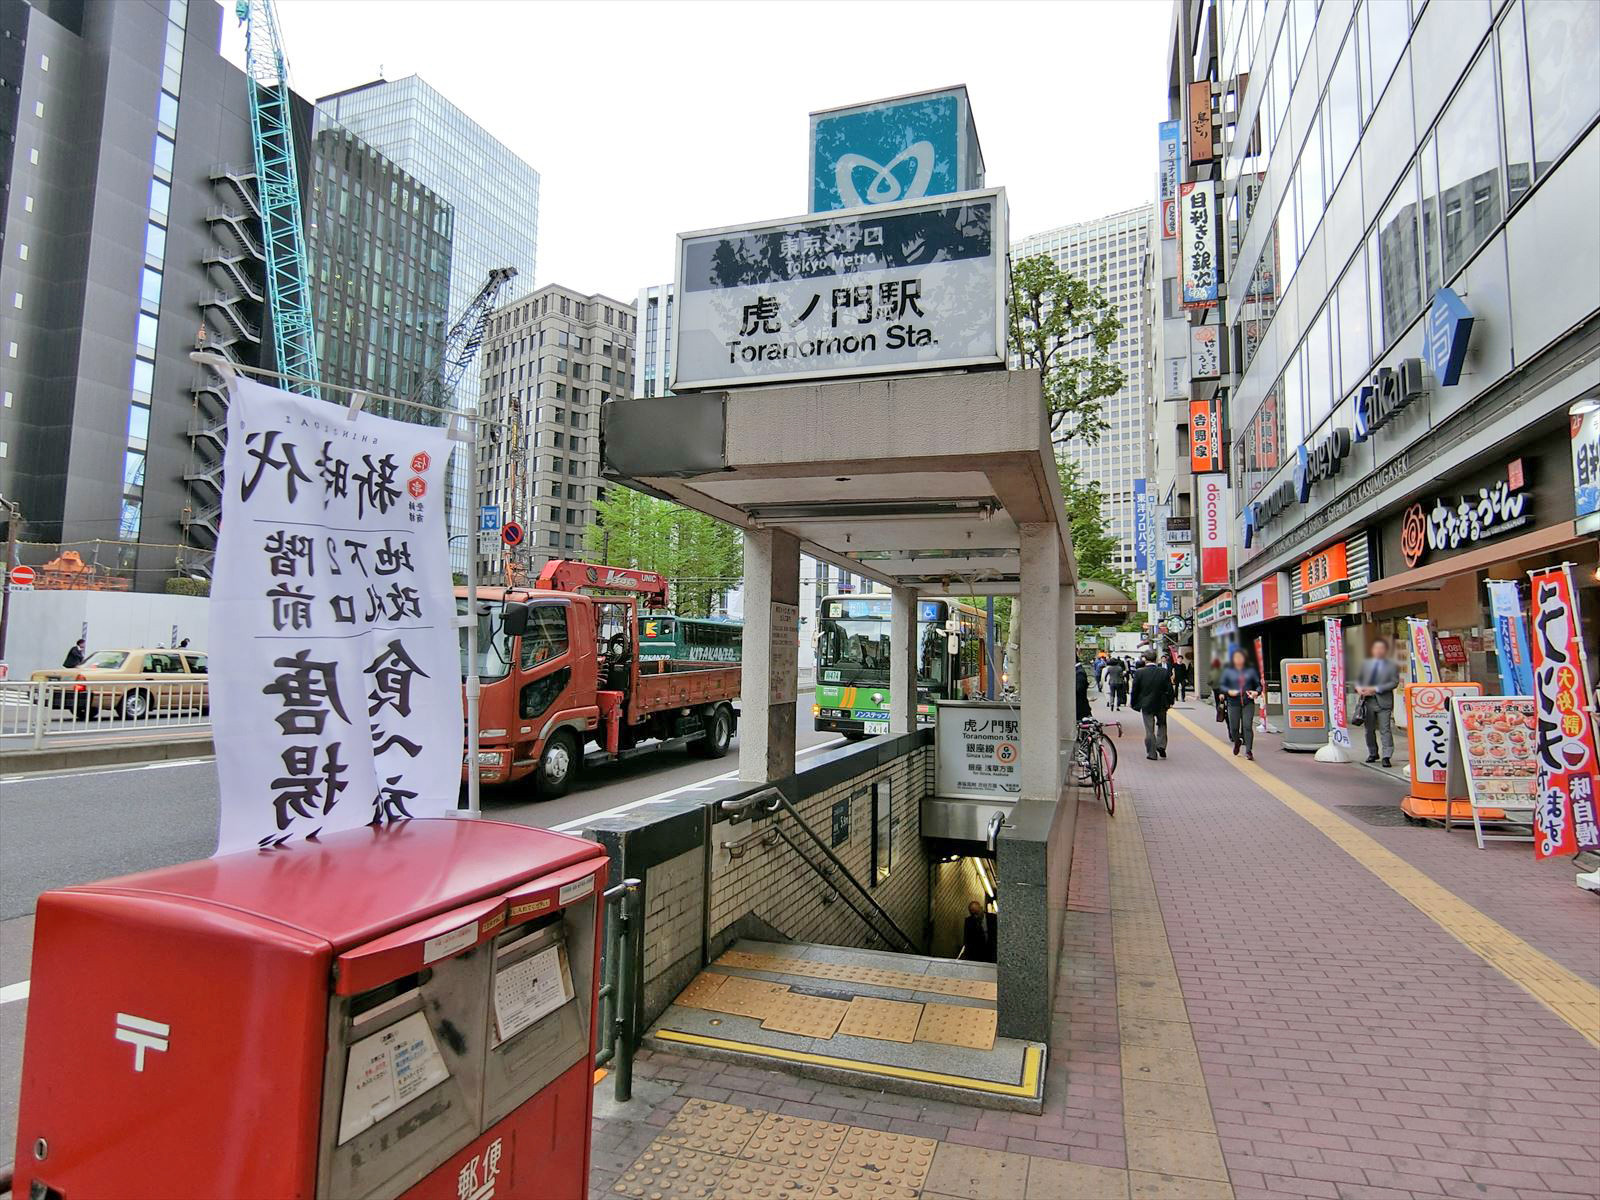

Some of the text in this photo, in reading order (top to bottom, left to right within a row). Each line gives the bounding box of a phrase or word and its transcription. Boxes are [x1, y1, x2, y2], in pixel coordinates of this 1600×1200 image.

[779, 227, 884, 257] 東京メトロ
[1190, 191, 1212, 289] 目利きの銀次
[785, 251, 876, 275] Tokyo Metro
[739, 279, 925, 337] 虎ノ門駅
[726, 324, 939, 364] Toranomon Sta.
[1198, 354, 1210, 376] うどん
[1204, 338, 1217, 370] はなまる
[1353, 358, 1422, 443] Kaikan
[1193, 413, 1208, 458] 吉野家
[1210, 412, 1218, 458] YOSHINOYA
[1356, 449, 1410, 503] KASUMIGASEKI
[1136, 493, 1147, 557] 東洋プロパティ
[1207, 483, 1219, 541] docomo
[1426, 481, 1524, 550] はなまるうどん
[641, 574, 657, 583] UNIC
[1290, 674, 1320, 684] 吉野家
[963, 733, 1004, 741] Toranomon
[964, 719, 1019, 734] 虎ノ門駅
[1425, 719, 1449, 769] うどん
[966, 743, 995, 754] 銀座線
[985, 764, 1014, 773] 浅草方面
[457, 1137, 503, 1199] 郵便
